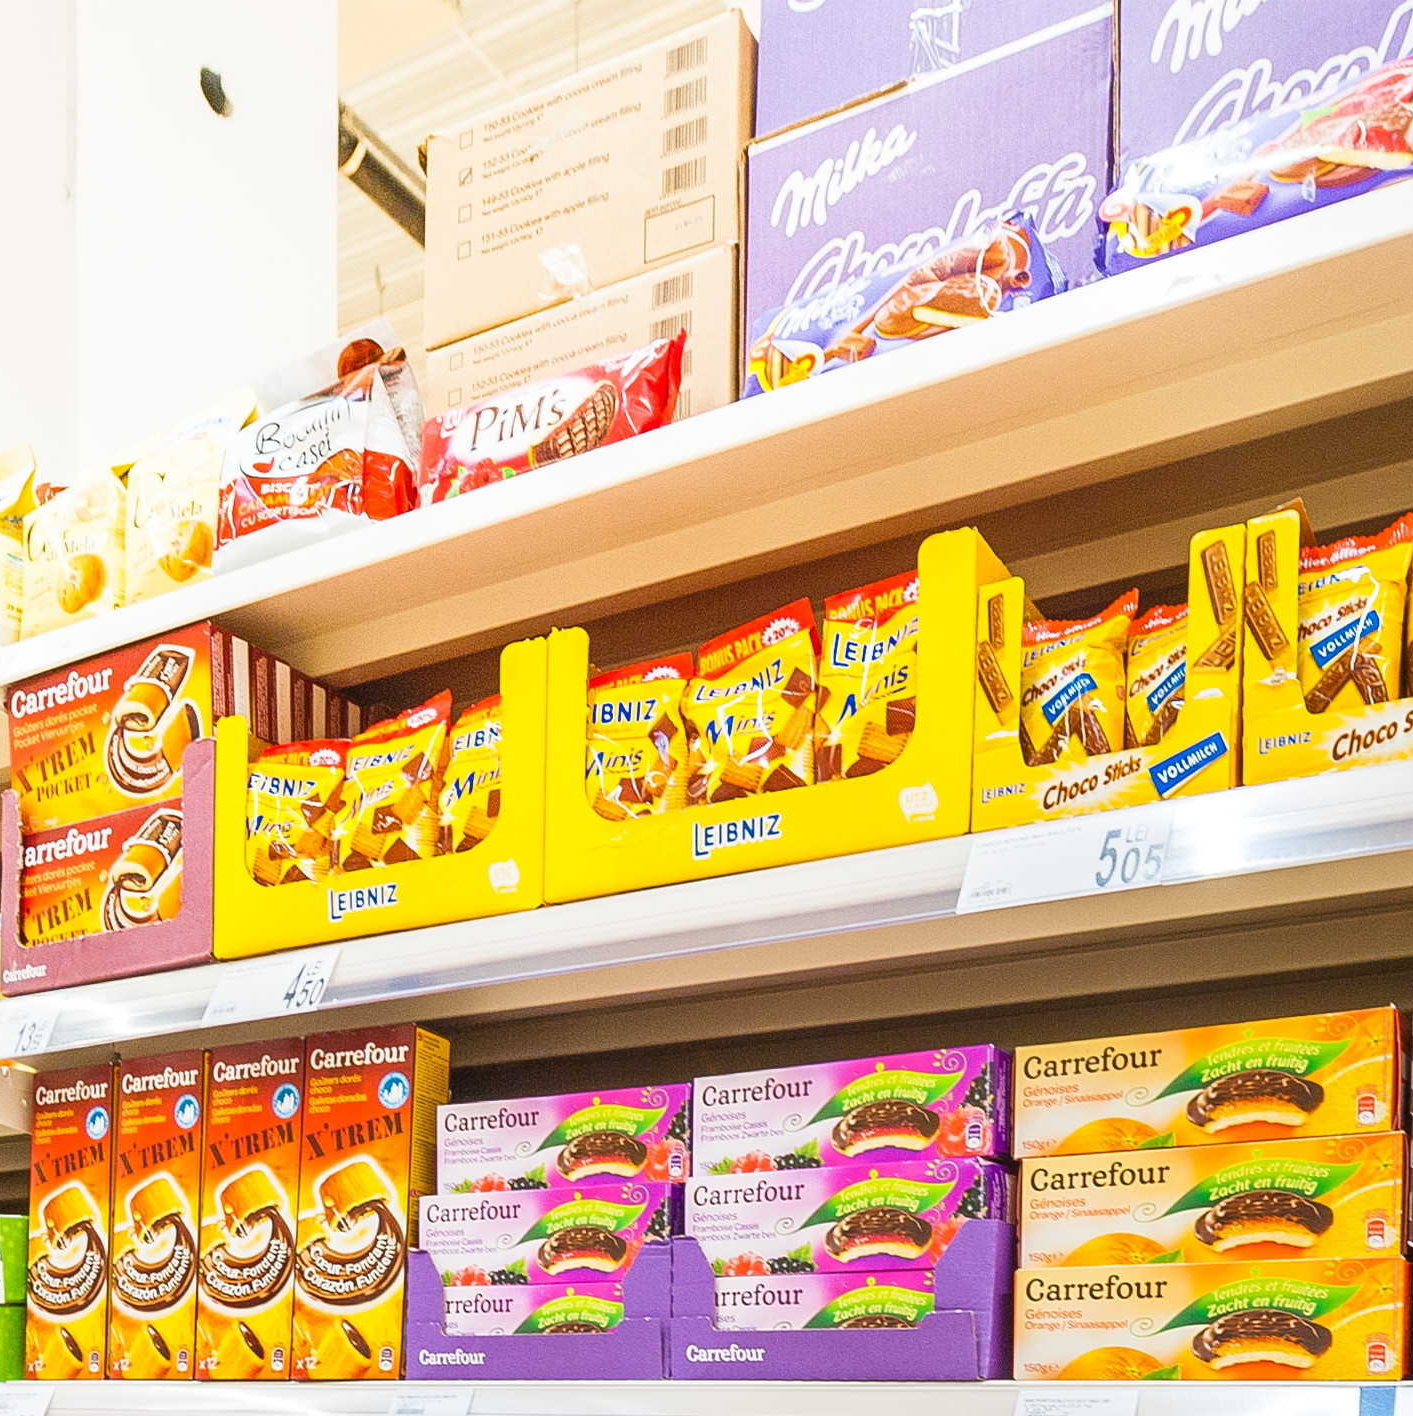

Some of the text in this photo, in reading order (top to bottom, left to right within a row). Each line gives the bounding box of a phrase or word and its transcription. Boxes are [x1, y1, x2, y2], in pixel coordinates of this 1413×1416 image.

[770, 122, 918, 236] Milka
[735, 631, 763, 658] PACK
[11, 667, 113, 720] Carrefour
[705, 711, 776, 745] Minis
[1259, 731, 1311, 755] LEIBNIZ
[1331, 721, 1400, 763] Choco
[36, 772, 93, 803] POCKET
[328, 883, 398, 921] LEIBNIZ
[310, 1043, 409, 1071] Carrefour
[1023, 1047, 1162, 1080] Carrefour
[1244, 1057, 1264, 1069] en
[1265, 1052, 1309, 1073] fruitig
[702, 1078, 813, 1107] Carrefour
[701, 1110, 746, 1123] Génoises
[305, 1111, 404, 1161] X'TREM
[296, 1356, 316, 1370] x12
[685, 1343, 765, 1365] Carrefour
